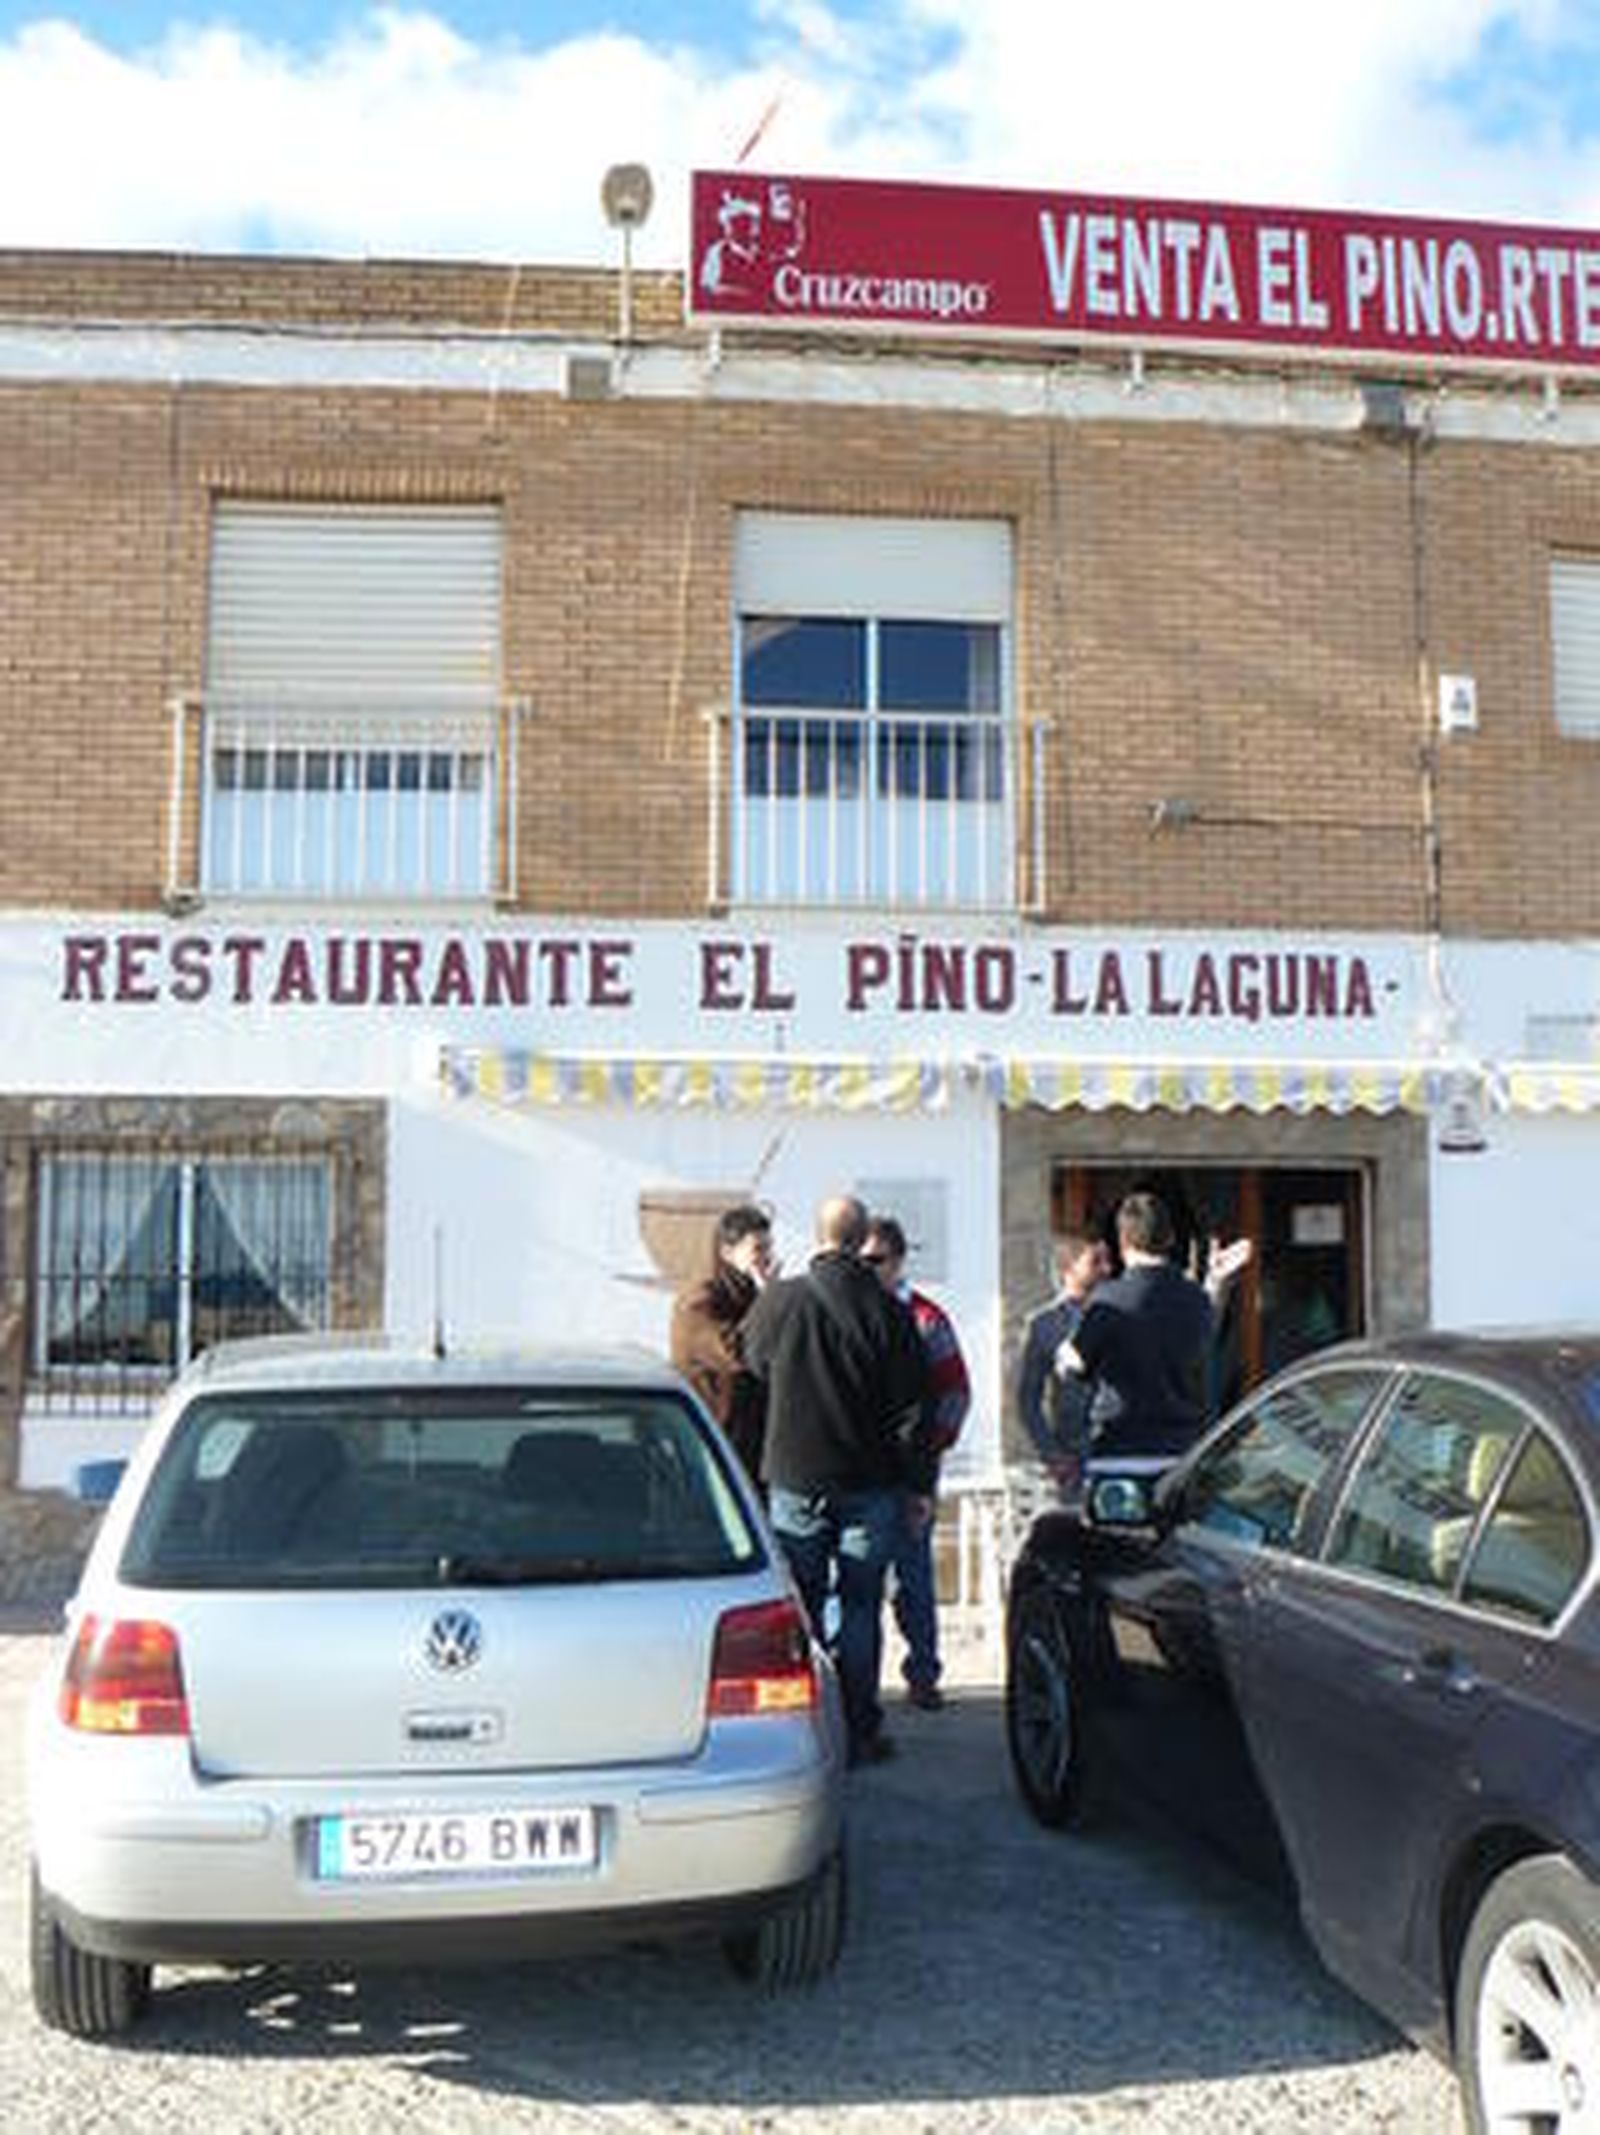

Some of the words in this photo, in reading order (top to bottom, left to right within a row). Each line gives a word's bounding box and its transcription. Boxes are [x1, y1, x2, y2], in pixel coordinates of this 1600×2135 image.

[773, 264, 989, 317] Cruzcampo
[1039, 211, 1240, 323] VENTA
[1257, 226, 1330, 331] EL
[61, 934, 634, 1007] RESTAURANTE
[699, 942, 796, 1011] EL
[351, 1820, 468, 1866] 5746
[489, 1814, 582, 1861] BWW
